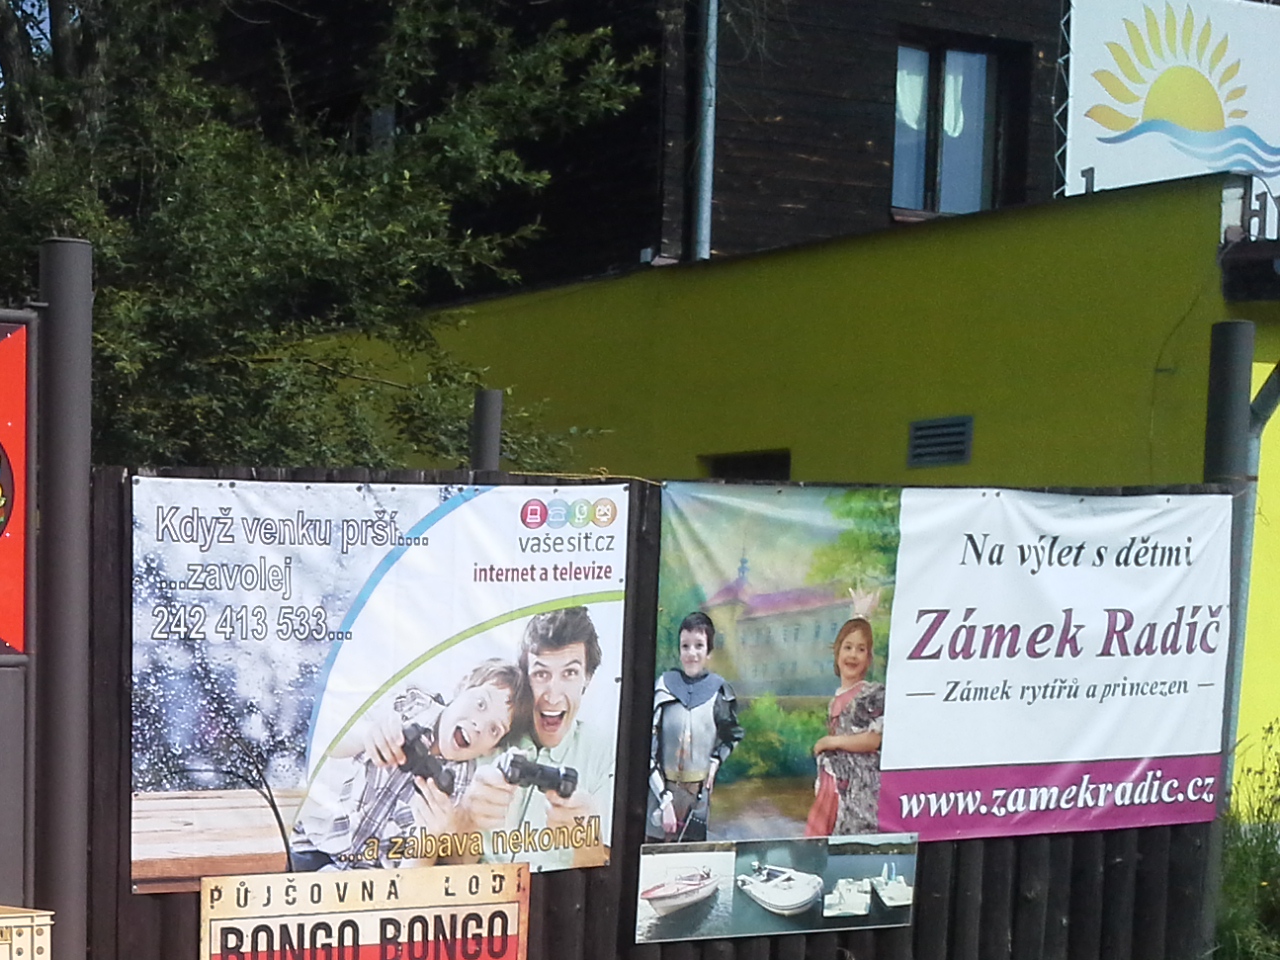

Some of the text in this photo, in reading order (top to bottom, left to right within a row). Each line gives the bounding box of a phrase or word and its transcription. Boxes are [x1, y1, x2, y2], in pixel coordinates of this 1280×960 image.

[156, 506, 234, 552] Když
[241, 510, 331, 545] venku
[474, 561, 612, 582] internet a televize
[960, 533, 1194, 575] Na výlet s dětmi
[151, 605, 206, 640] 242
[216, 605, 268, 640] 413
[906, 605, 1224, 660] Zámek Radíč
[943, 677, 1189, 706] Zámek rytířů a princezen
[899, 770, 1215, 819] www.zamekradic.cz
[387, 827, 483, 860] zábava
[493, 815, 600, 855] nekončí!
